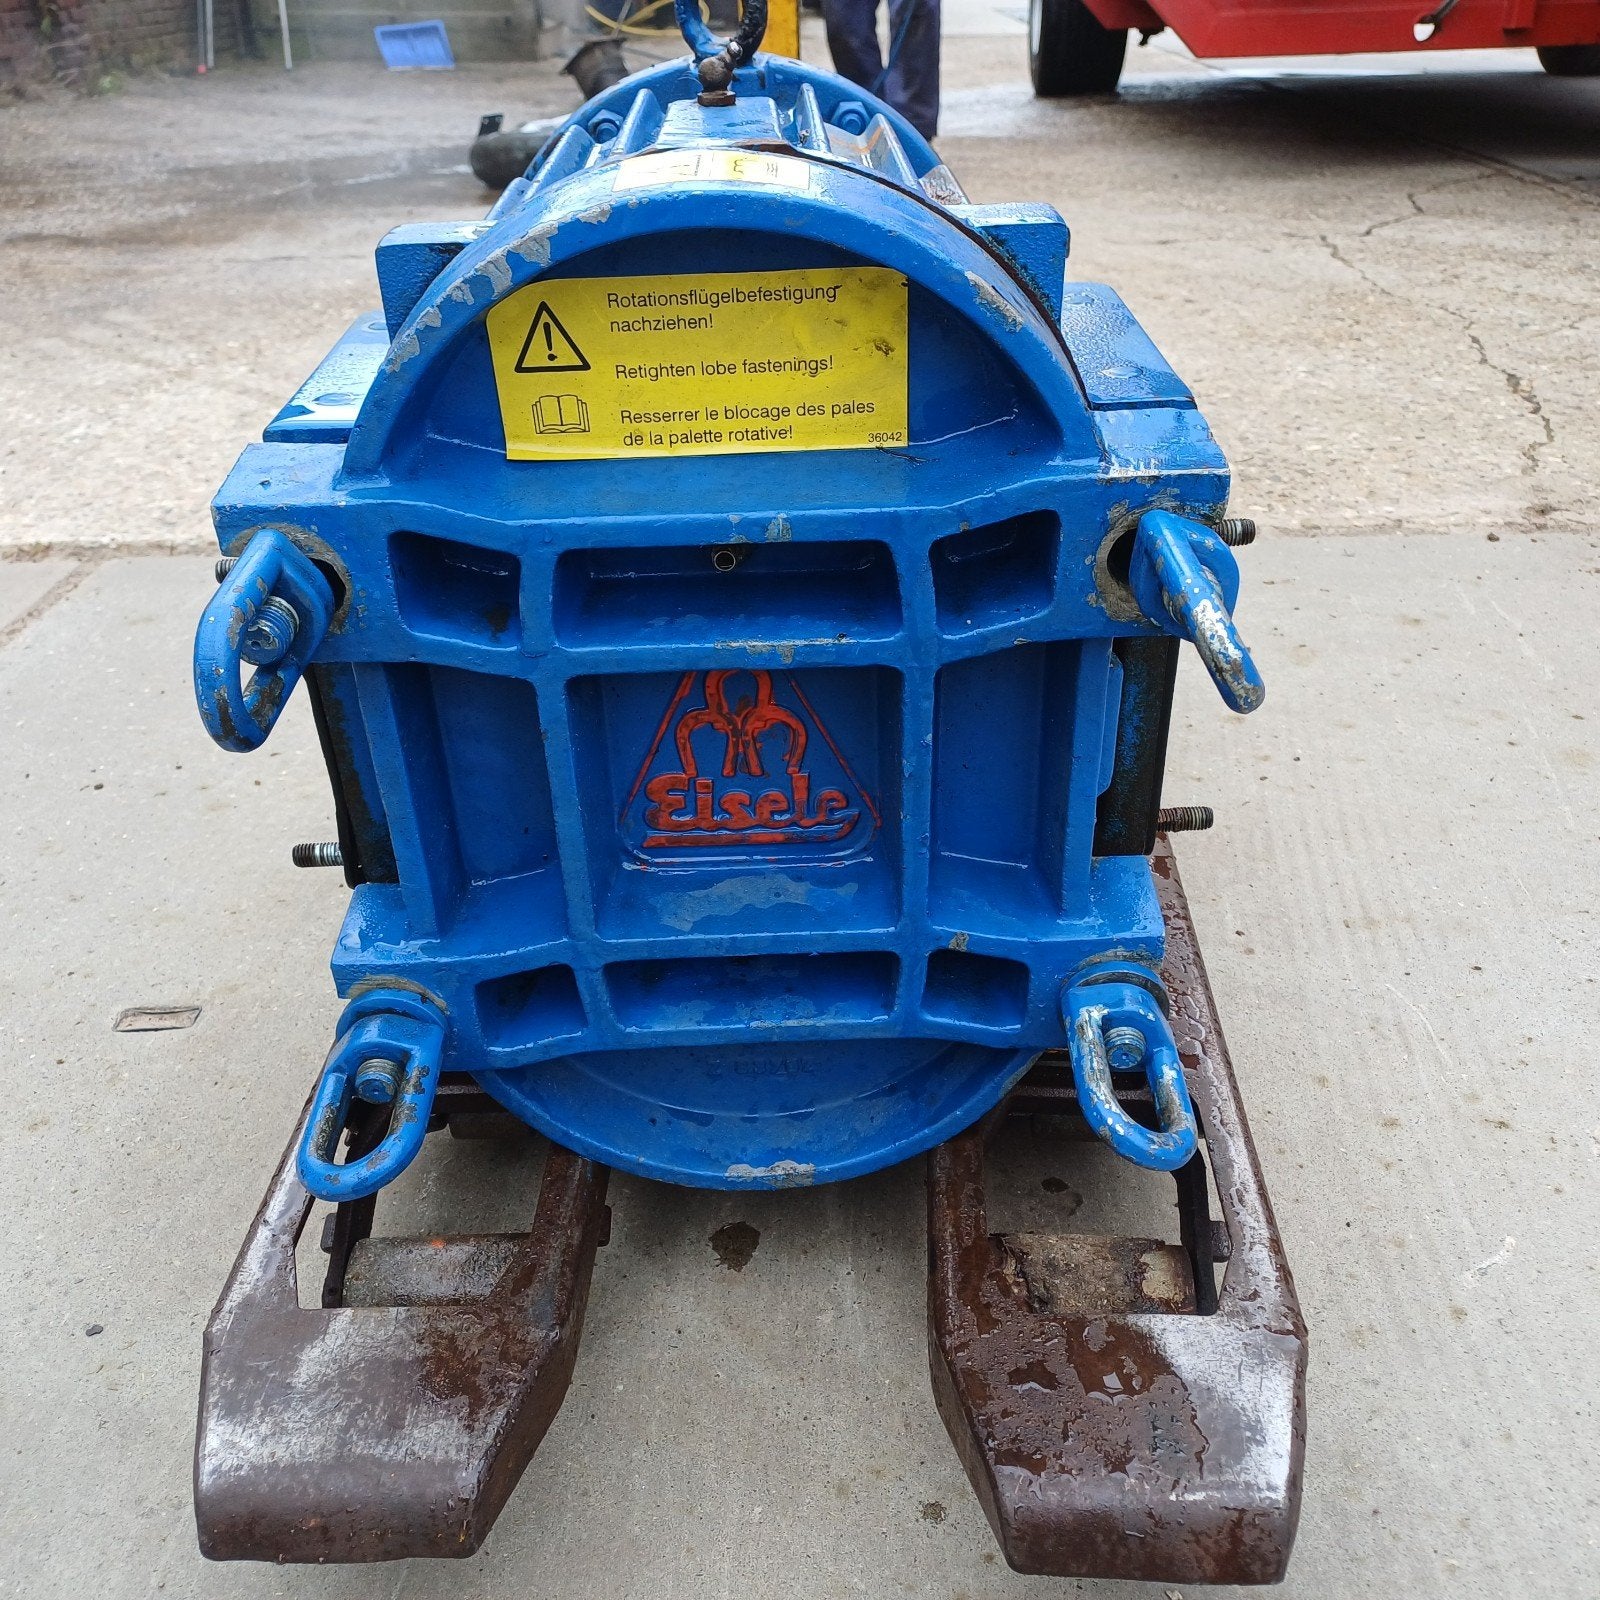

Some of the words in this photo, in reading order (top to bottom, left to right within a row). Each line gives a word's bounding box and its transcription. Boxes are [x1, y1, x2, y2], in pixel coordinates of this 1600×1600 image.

[607, 285, 837, 309] Rotationsflügelbefestigung
[610, 316, 713, 333] nachziehen!
[615, 363, 696, 382] Retighten
[701, 360, 737, 376] lobe
[741, 355, 833, 376] fastenings!
[620, 409, 700, 425] Resserrer
[705, 406, 719, 421] le
[724, 404, 791, 422] blocage
[796, 402, 825, 417] des
[831, 400, 875, 418] pales
[623, 431, 644, 447] de
[649, 431, 665, 446] la
[669, 428, 723, 449] palette
[728, 425, 793, 443] rotative!
[867, 432, 903, 444] 36042
[645, 773, 849, 831] Eisele
